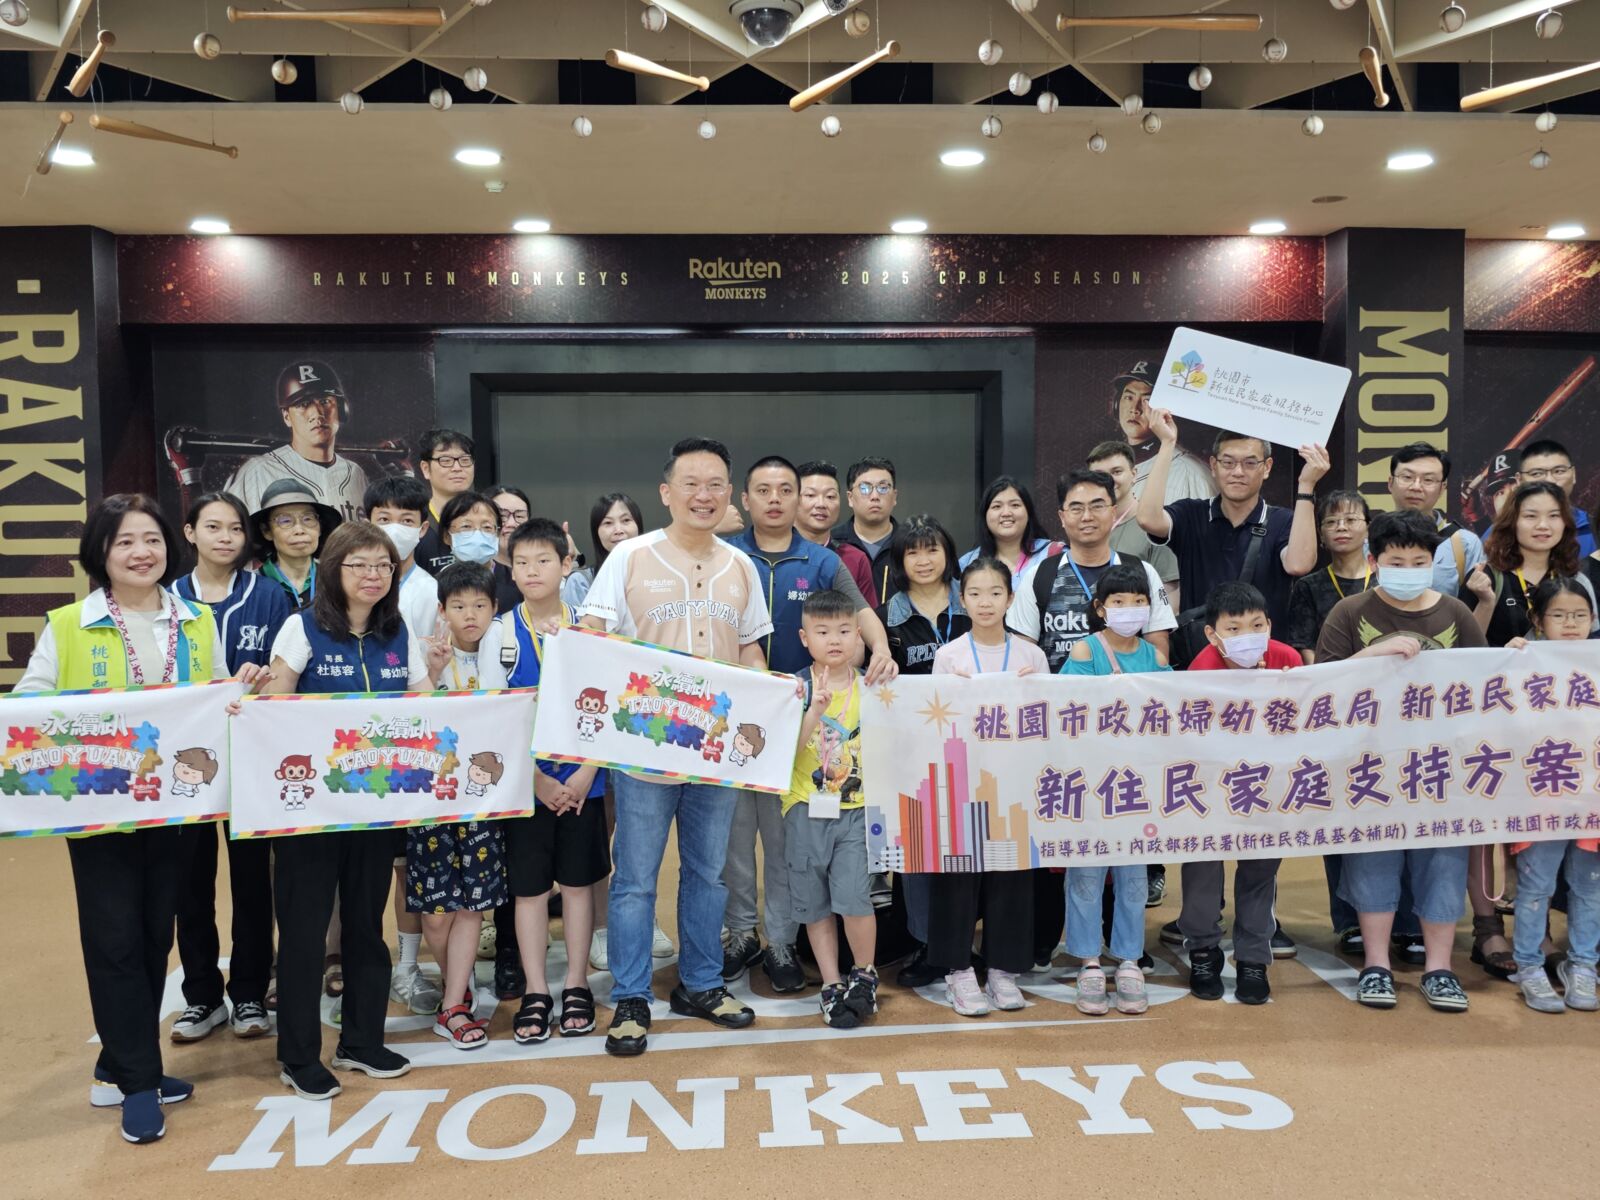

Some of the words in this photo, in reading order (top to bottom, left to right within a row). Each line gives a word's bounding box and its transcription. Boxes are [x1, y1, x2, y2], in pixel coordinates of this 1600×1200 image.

[314, 271, 455, 286] RAKUTEN
[488, 271, 628, 286] MONKEYS
[689, 257, 781, 279] Rakuten
[841, 271, 909, 285] 2025
[938, 271, 1005, 285] CPBL
[1034, 271, 1141, 285] SEASON
[705, 288, 767, 300] MONKEYS
[1214, 367, 1252, 387] 桃園市
[1210, 380, 1324, 417] 新住民家庭服務中心
[787, 590, 813, 601] 婦幼
[317, 664, 355, 676] 杜慈容
[624, 695, 717, 731] TAOYUAN
[974, 688, 1382, 742] 桃園市政府婦幼發展局
[1399, 671, 1600, 720] 新住民家庭
[9, 744, 145, 775] TAOYUAN
[335, 746, 446, 773] TAOYUAN
[1034, 736, 1600, 822] 新住民家庭支持方案
[207, 1060, 1294, 1172] MONKEYS
